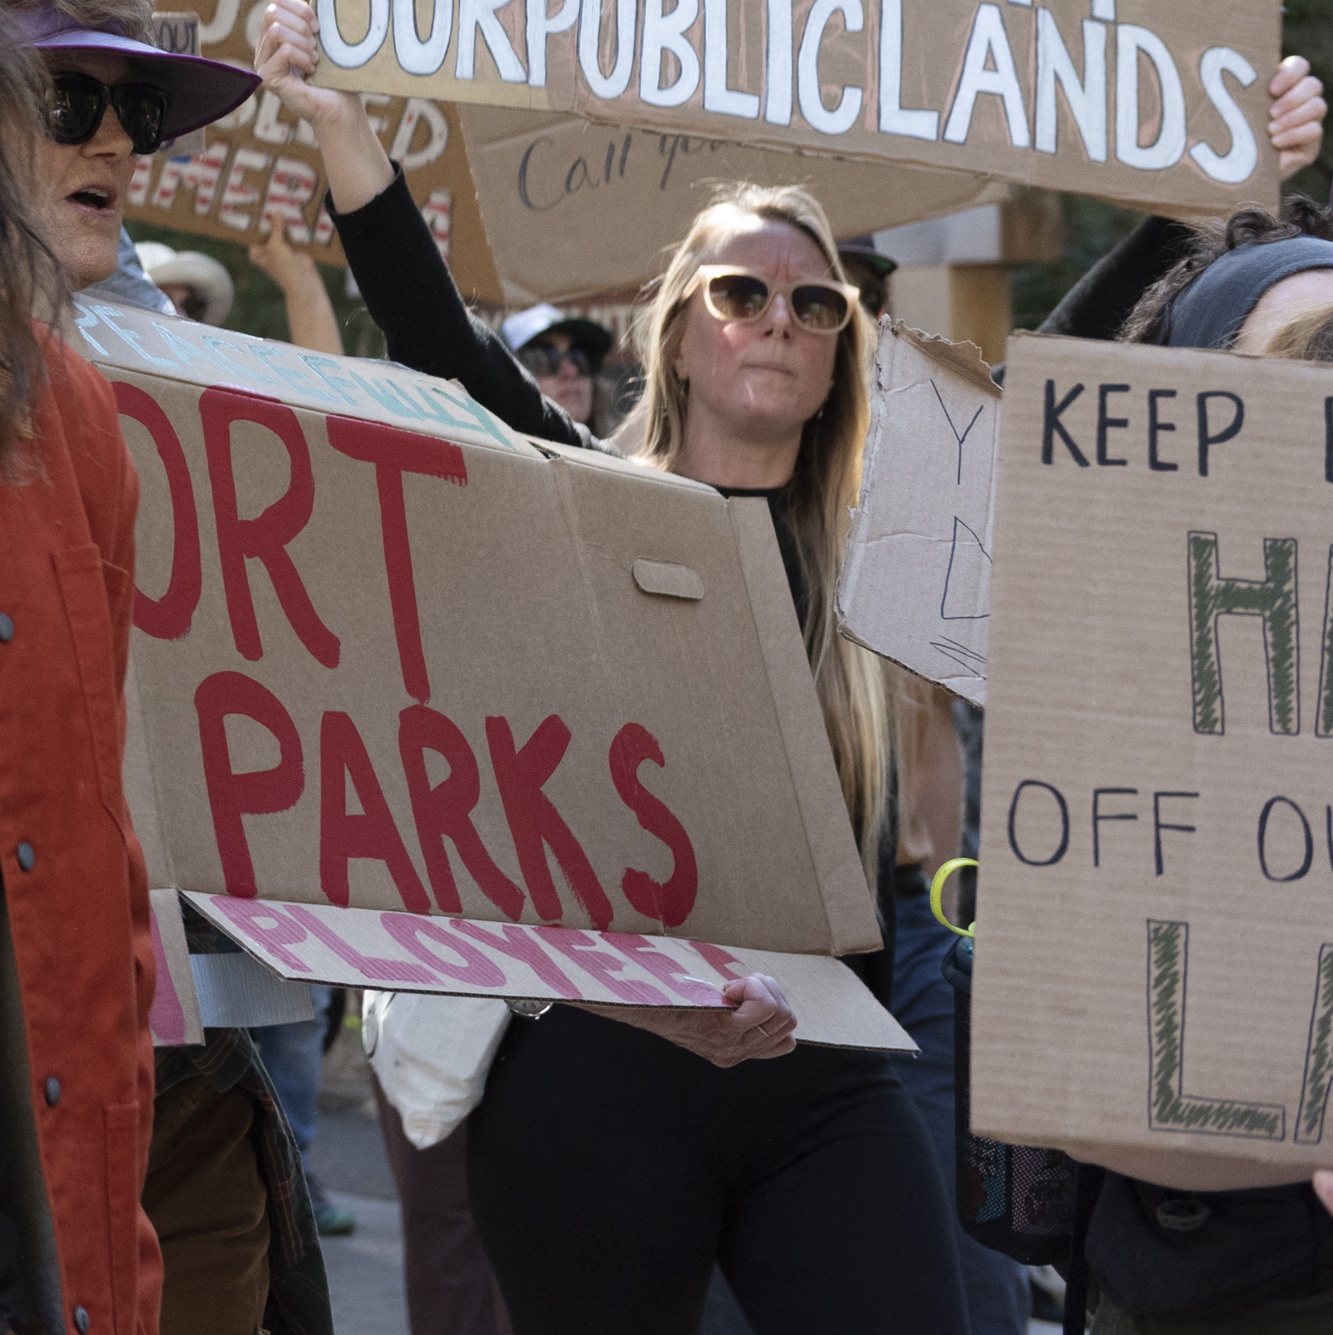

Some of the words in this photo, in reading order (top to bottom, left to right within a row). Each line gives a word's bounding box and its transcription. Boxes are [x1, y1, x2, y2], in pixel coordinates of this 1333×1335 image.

[518, 135, 632, 212] Call
[1042, 379, 1245, 478] KEEP
[193, 671, 699, 933] PARKS
[1008, 779, 1201, 877] OFF
[1257, 795, 1333, 883] O
